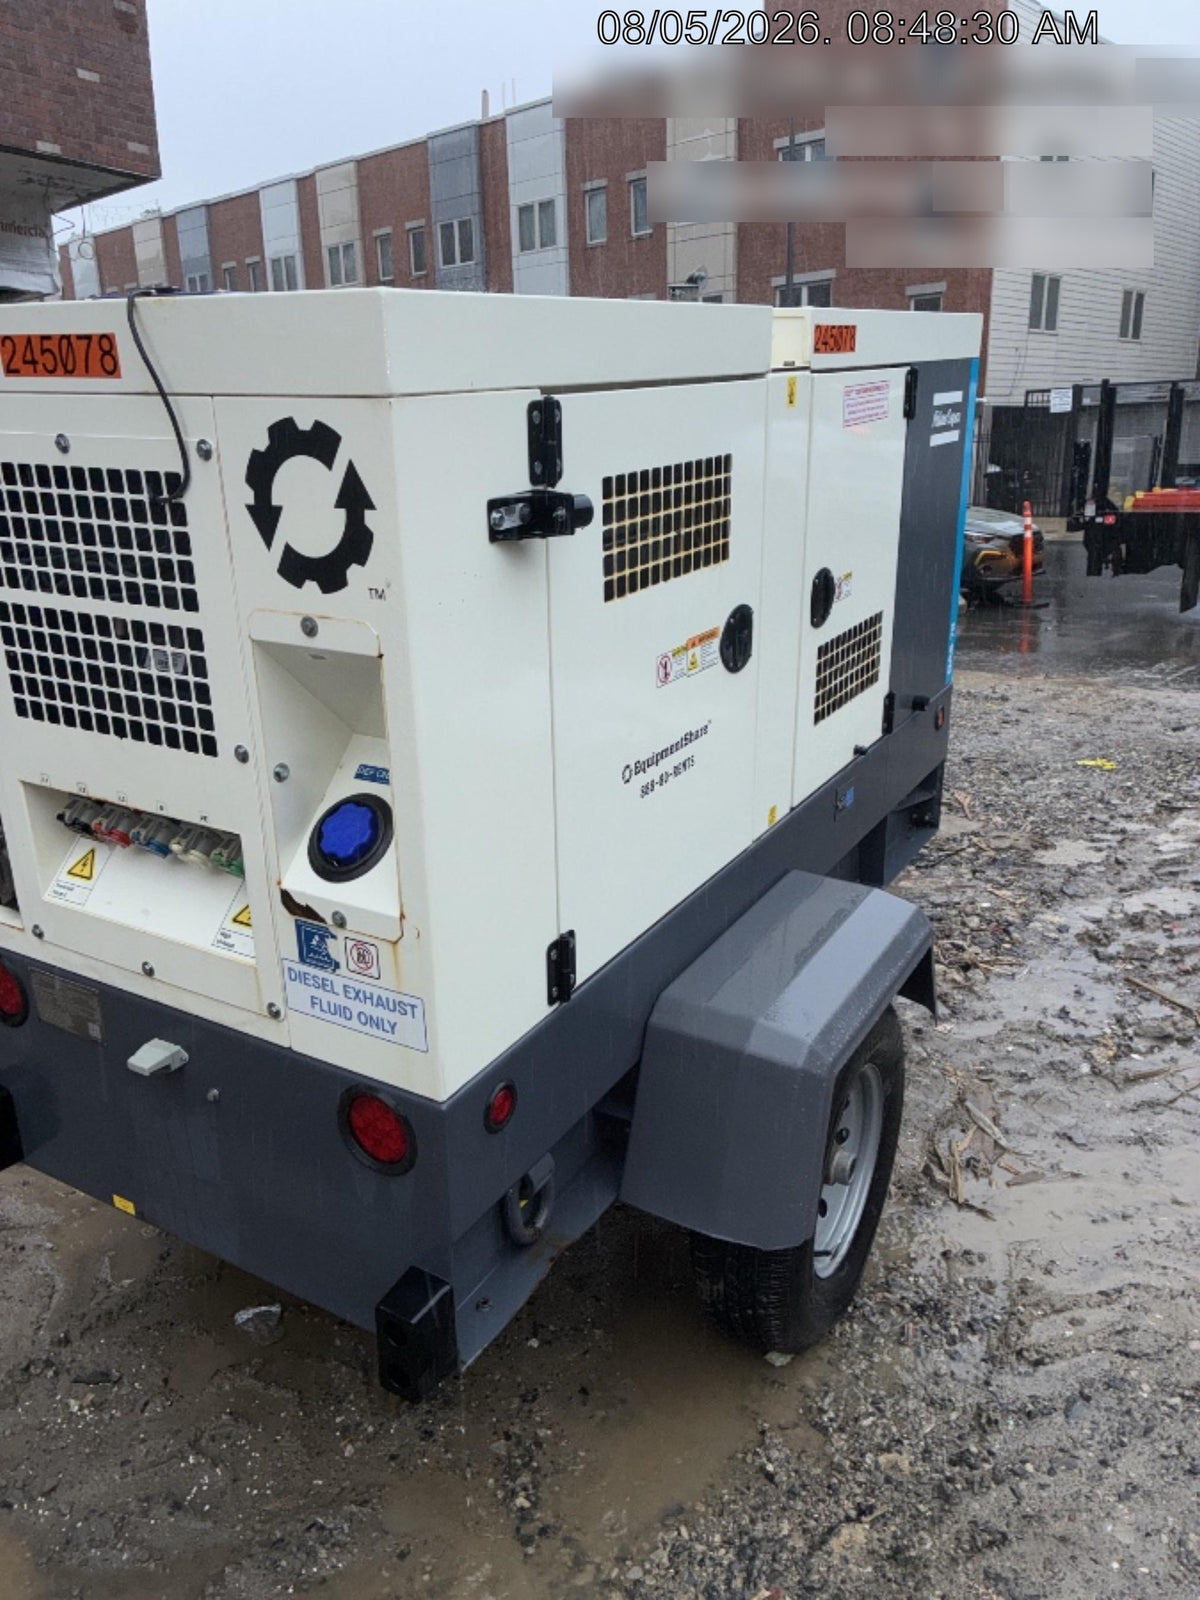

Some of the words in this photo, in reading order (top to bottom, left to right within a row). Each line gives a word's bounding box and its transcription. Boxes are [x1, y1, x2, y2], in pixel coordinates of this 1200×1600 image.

[1, 333, 118, 375] 245078
[815, 324, 856, 352] 245078
[367, 587, 387, 601] TM
[633, 723, 709, 777] EquipmentShare
[287, 966, 340, 996] DIESEL
[342, 983, 418, 1019] EXHAUST
[310, 995, 353, 1021] FLUID
[357, 1011, 397, 1036] ONLY
